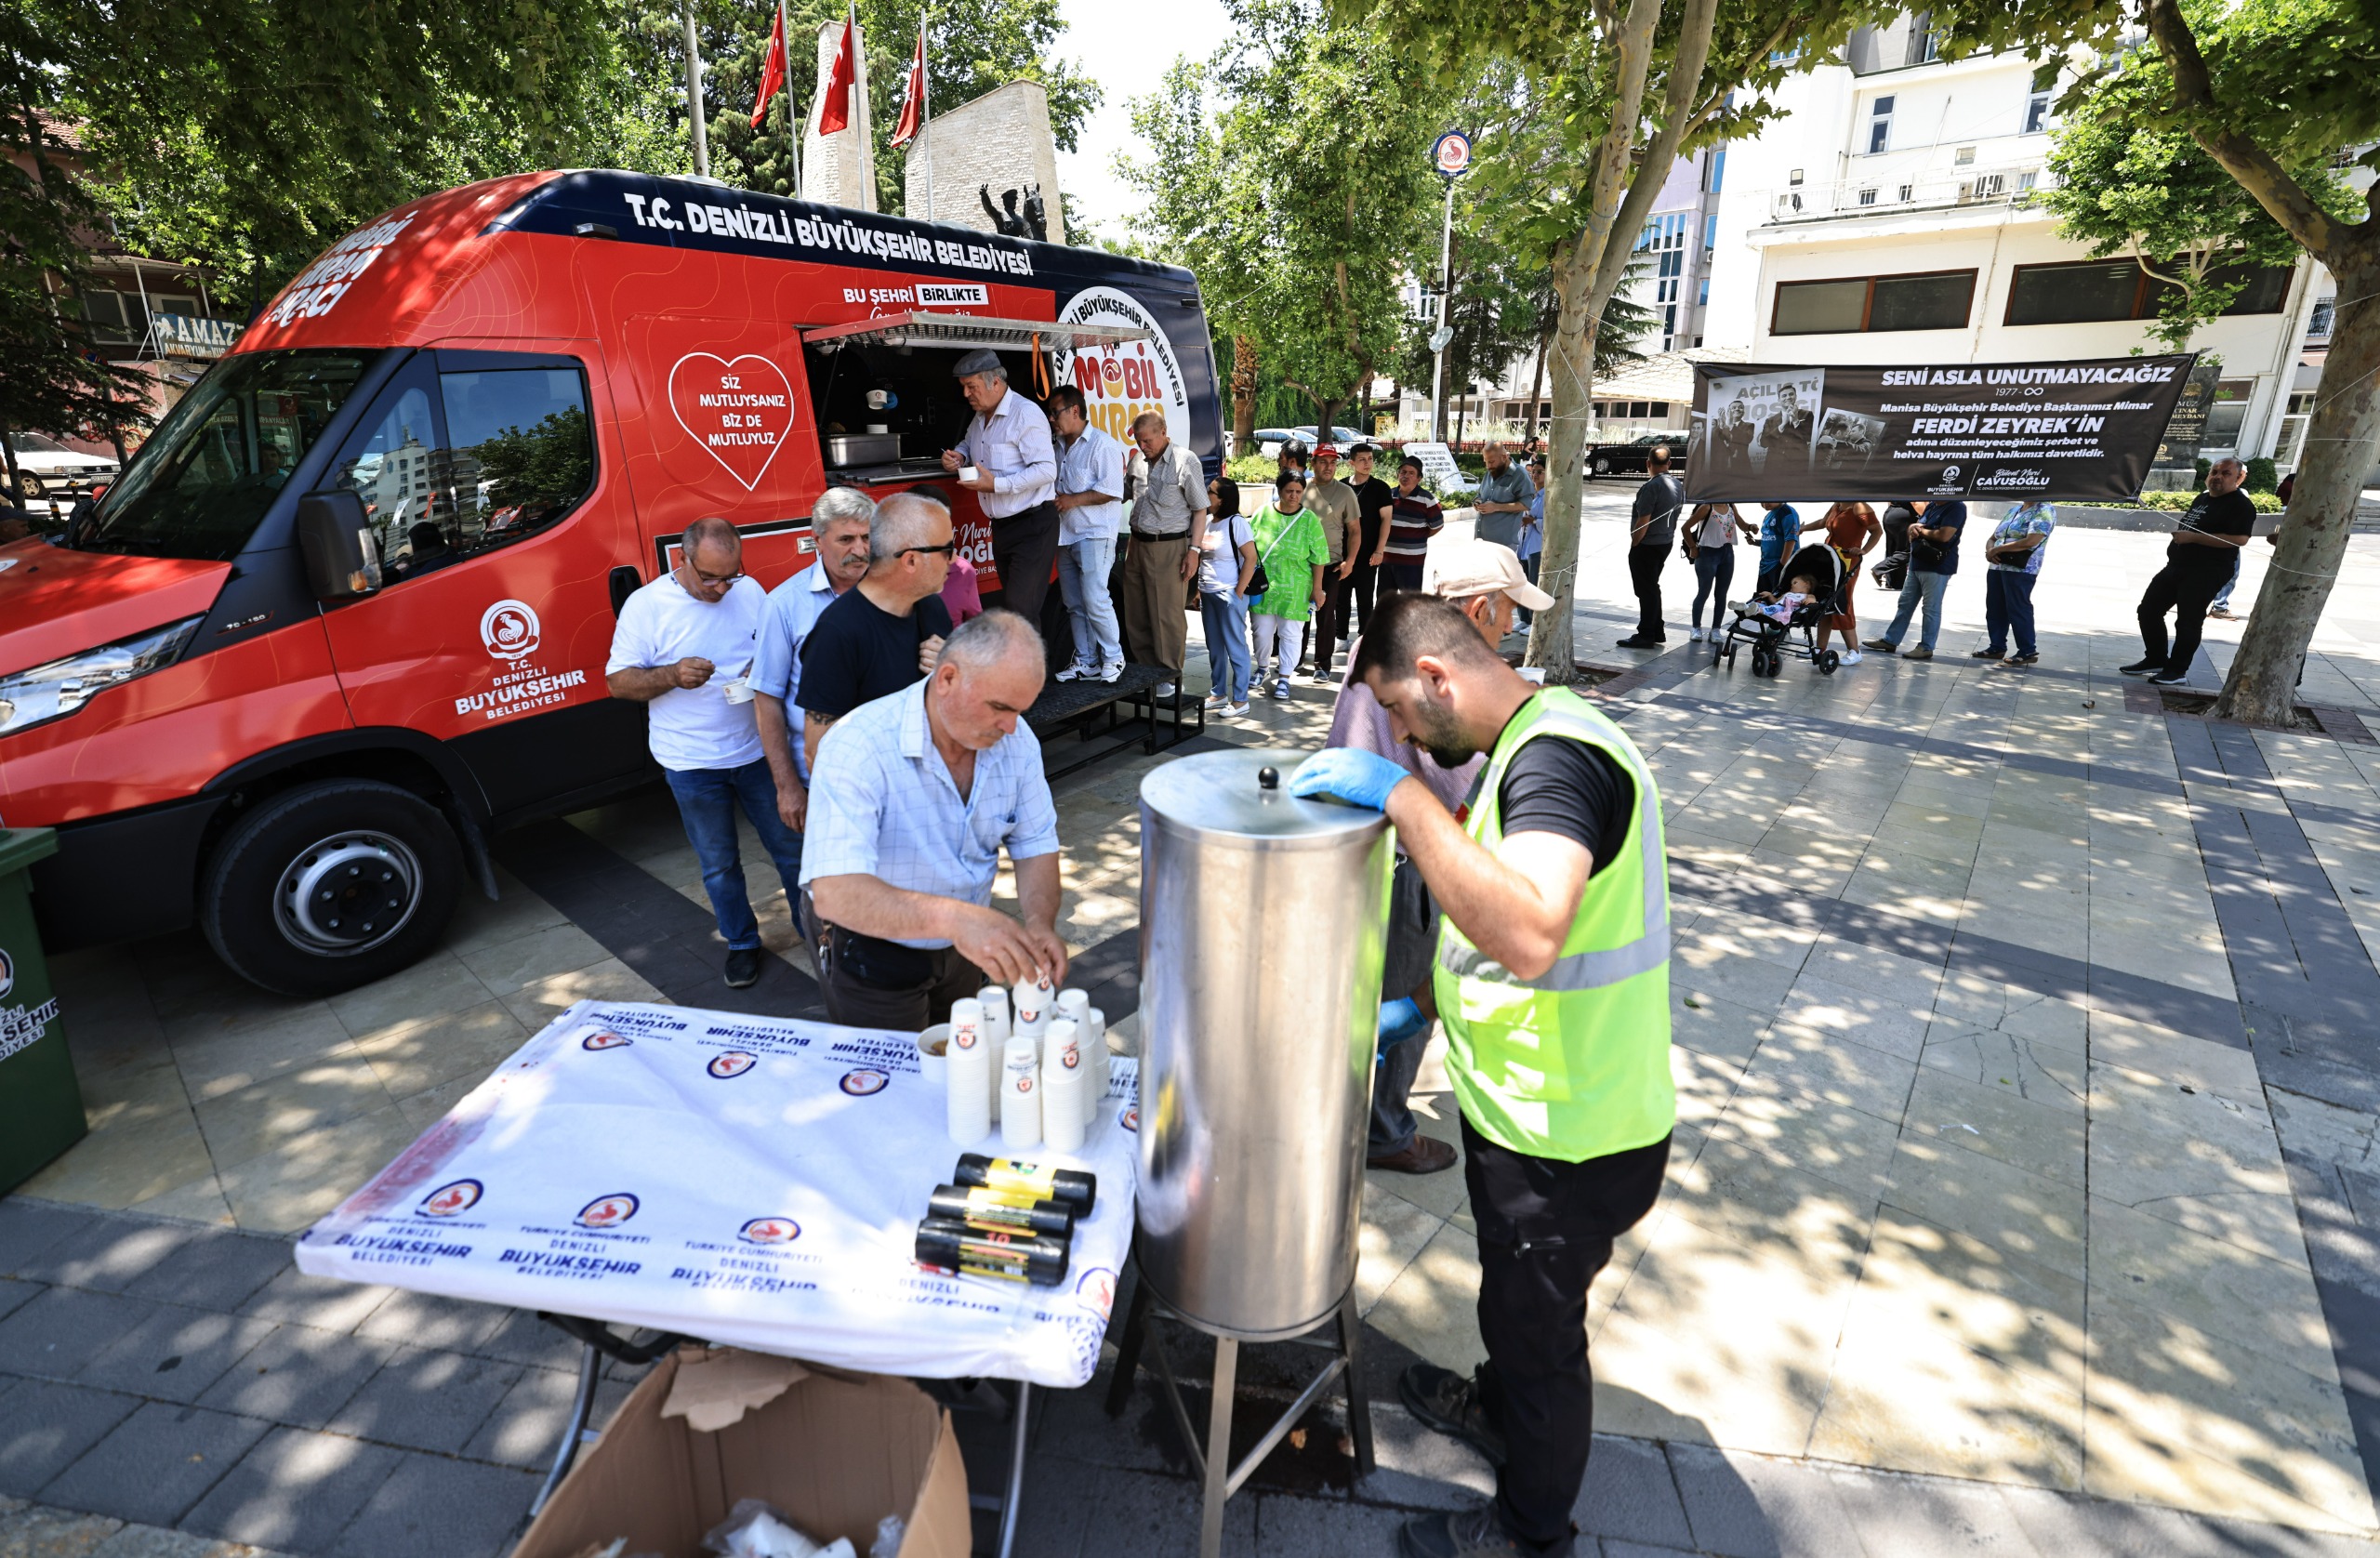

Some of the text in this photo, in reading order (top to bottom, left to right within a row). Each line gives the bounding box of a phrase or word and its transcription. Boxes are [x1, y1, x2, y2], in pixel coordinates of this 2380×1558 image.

[624, 192, 1034, 276] T.C. DENİZLİ BÜYÜKŞEHİR BELEDİYESİ
[842, 285, 982, 305] BU ŞEHRİ BİRLİKTE
[1078, 294, 1143, 326] BÜYÜKŞEHİR
[178, 316, 245, 346] AMAZ
[721, 373, 742, 390] SİZ
[1881, 363, 2176, 386] SENİ ASLA UNUTMAYACAĞIZ
[699, 394, 787, 407] MUTLUYSANIZ
[1880, 400, 2154, 414] Manisa Büyükşehir Belediye Başkanımız Mimar
[721, 413, 762, 428] BİZ DE
[1911, 415, 1978, 434] FERDİ
[708, 432, 776, 446] MUTLUYUZ
[1906, 438, 1938, 446] adına
[1939, 437, 2044, 448] düzenleyeceğimiz
[2044, 437, 2082, 447] şerbet
[1893, 449, 2105, 461] helva hayrına tüm halkımız davetlidir.
[1976, 476, 2051, 486] ÇAVUŞOĞLU
[509, 659, 532, 671] T.C.
[493, 667, 547, 686] DENİZLİ
[455, 669, 587, 715] BÜYÜKŞEHİR
[486, 692, 565, 720] BELEDİYESİ
[985, 1231, 1012, 1248] 10
